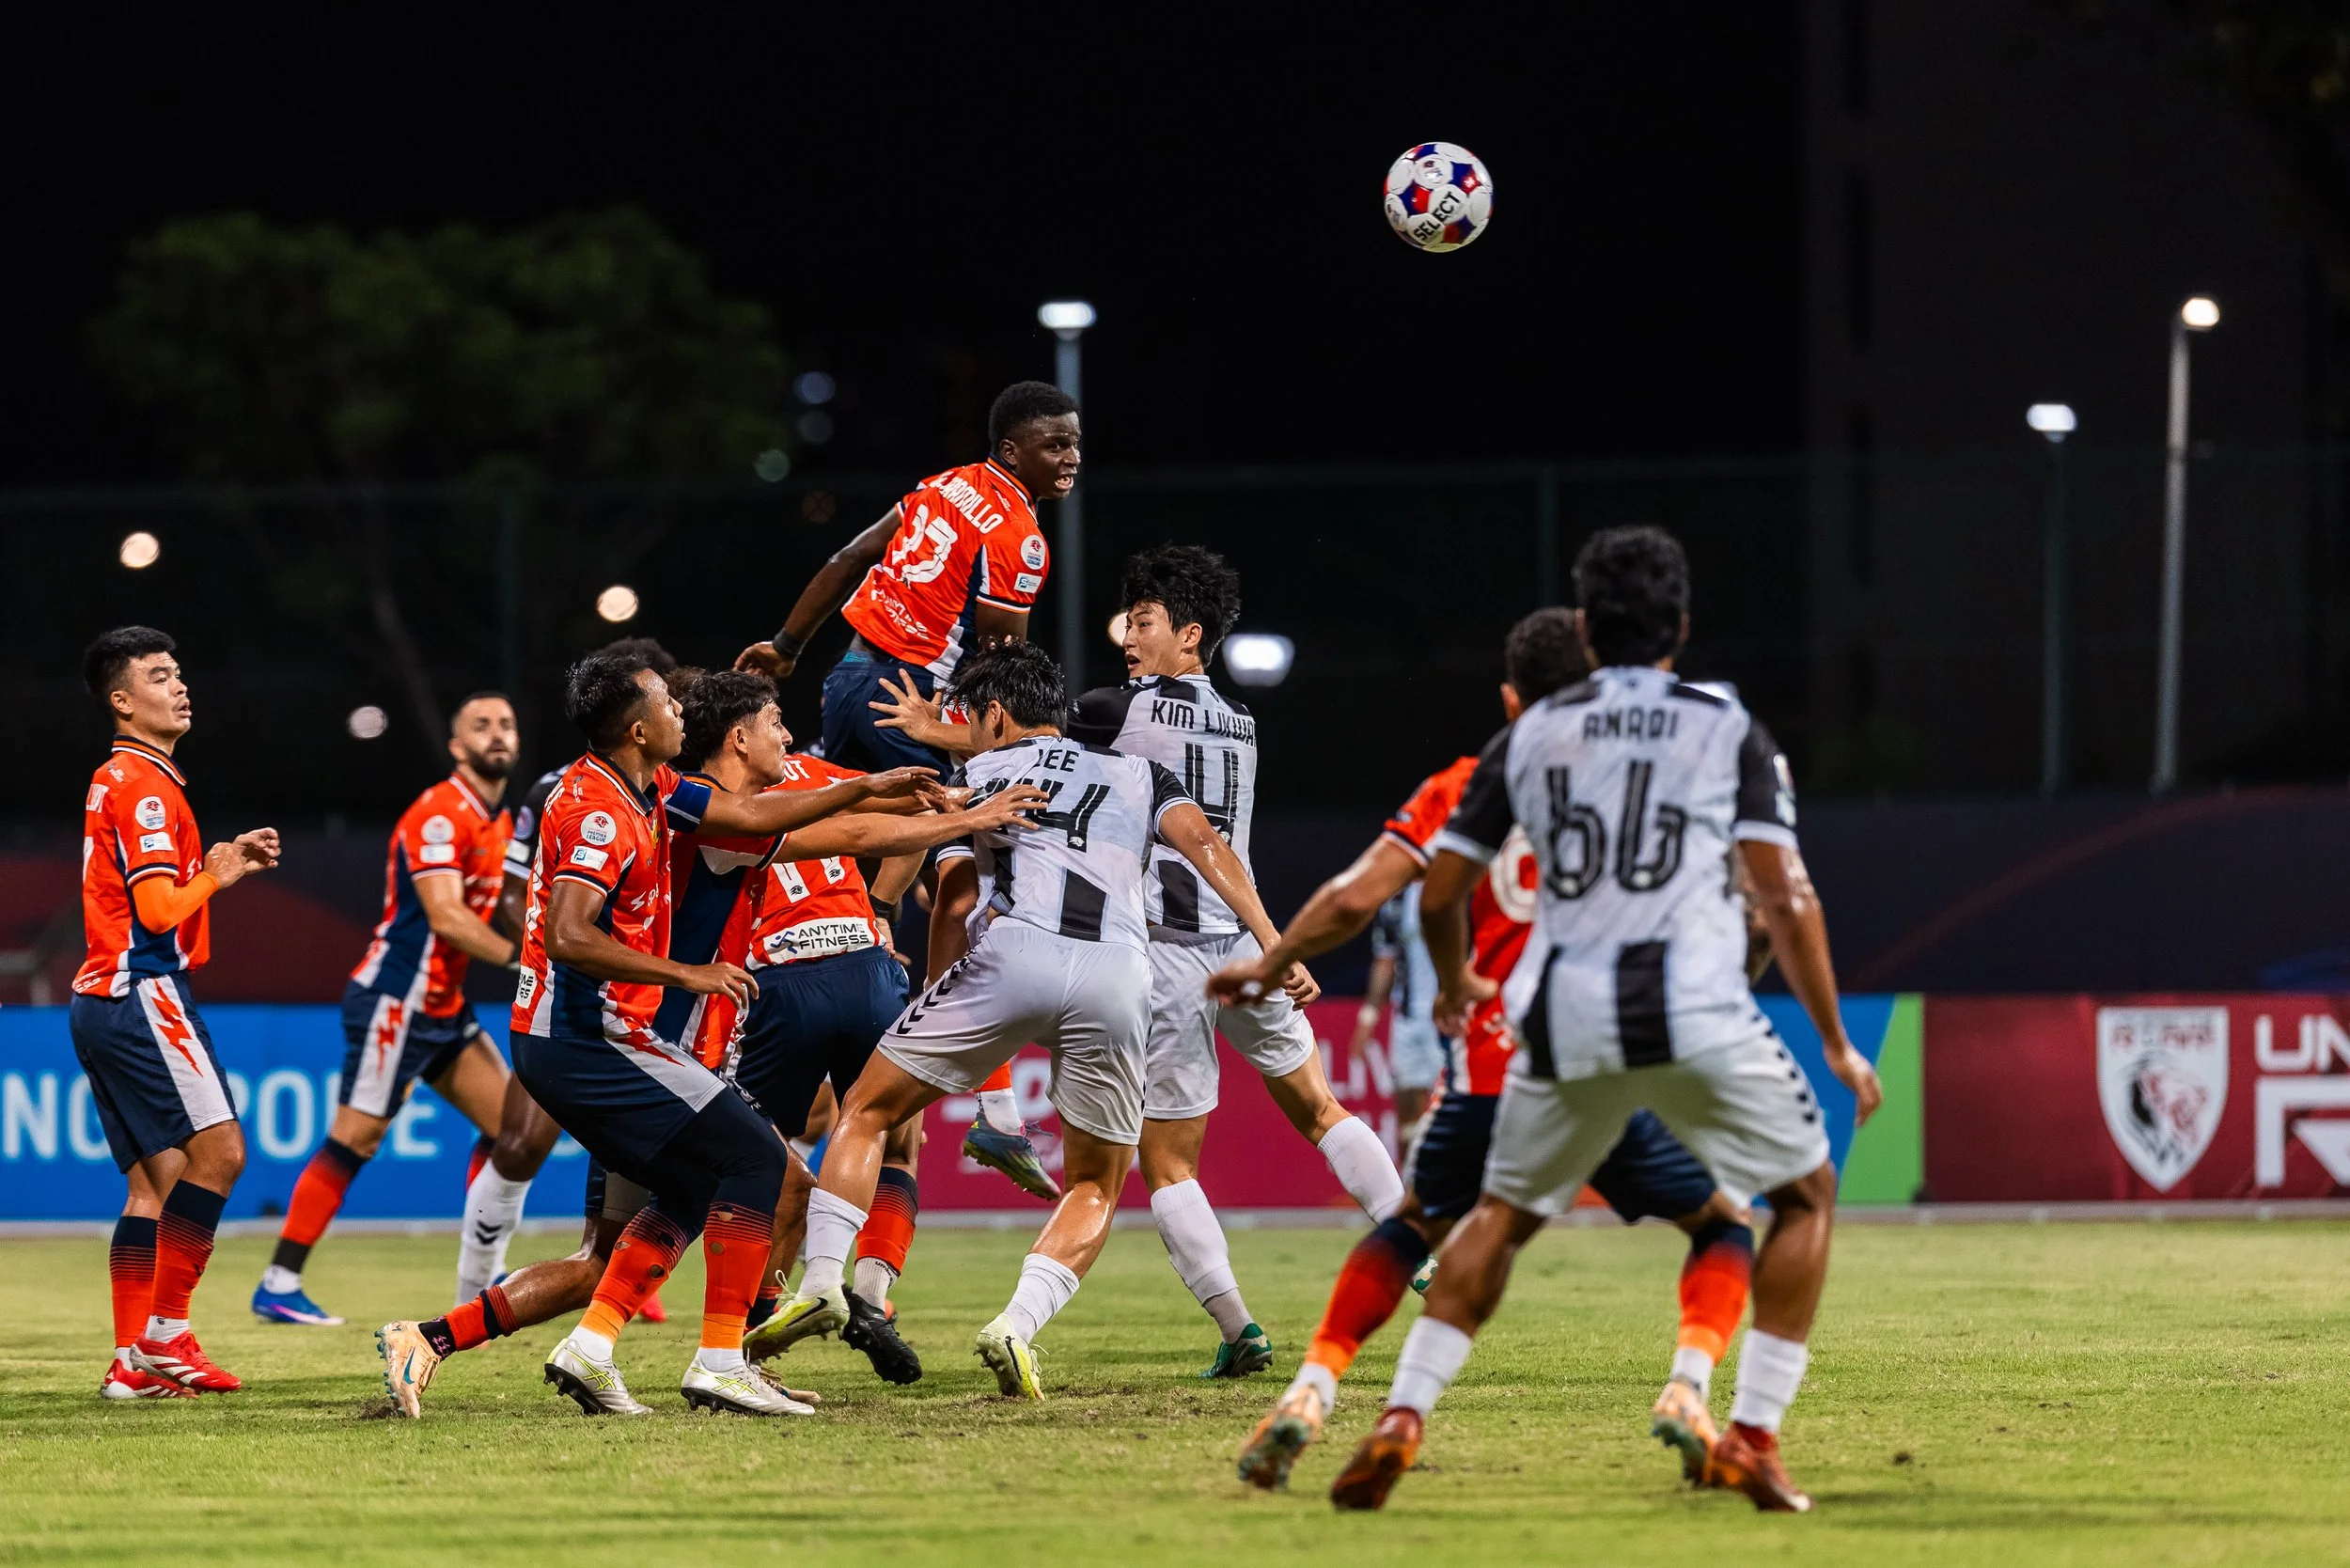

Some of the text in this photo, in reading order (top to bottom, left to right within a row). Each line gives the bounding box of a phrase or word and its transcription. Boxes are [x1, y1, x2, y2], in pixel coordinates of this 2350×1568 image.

[1414, 191, 1461, 241] SELECT
[1150, 699, 1258, 747] KIM LIKWA
[1033, 748, 1080, 773] LEE
[1546, 759, 1686, 900] 66
[798, 923, 866, 939] ANYTIME
[799, 934, 870, 949] FITNESS
